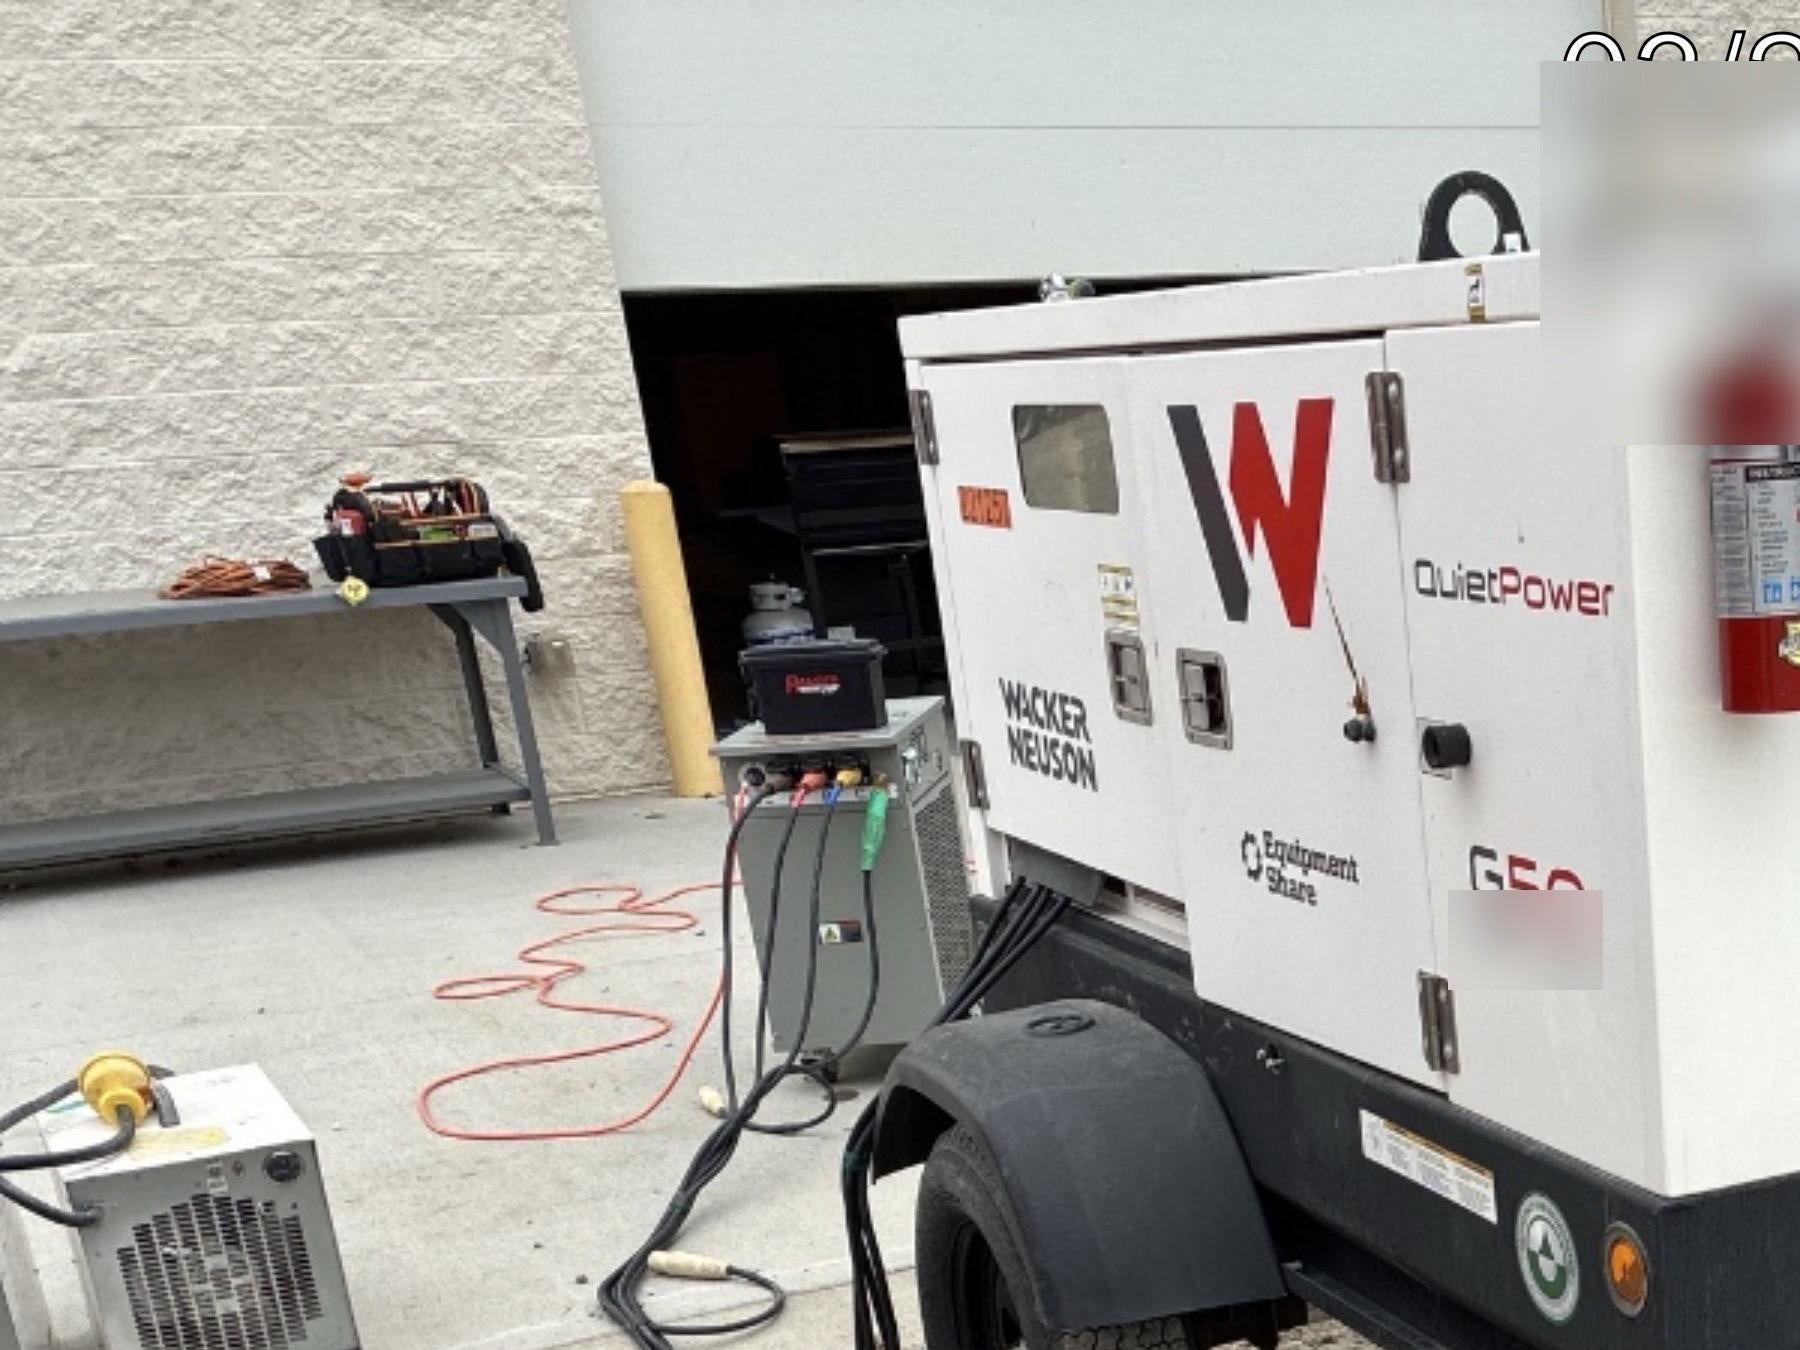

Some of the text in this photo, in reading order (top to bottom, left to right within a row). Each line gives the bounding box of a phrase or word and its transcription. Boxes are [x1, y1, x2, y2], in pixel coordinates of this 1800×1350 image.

[1413, 557, 1615, 617] QuietPower
[998, 676, 1093, 744] WACKER
[1007, 724, 1099, 793] NEUSON
[1262, 829, 1360, 885] Equipment
[1265, 865, 1318, 907] Share
